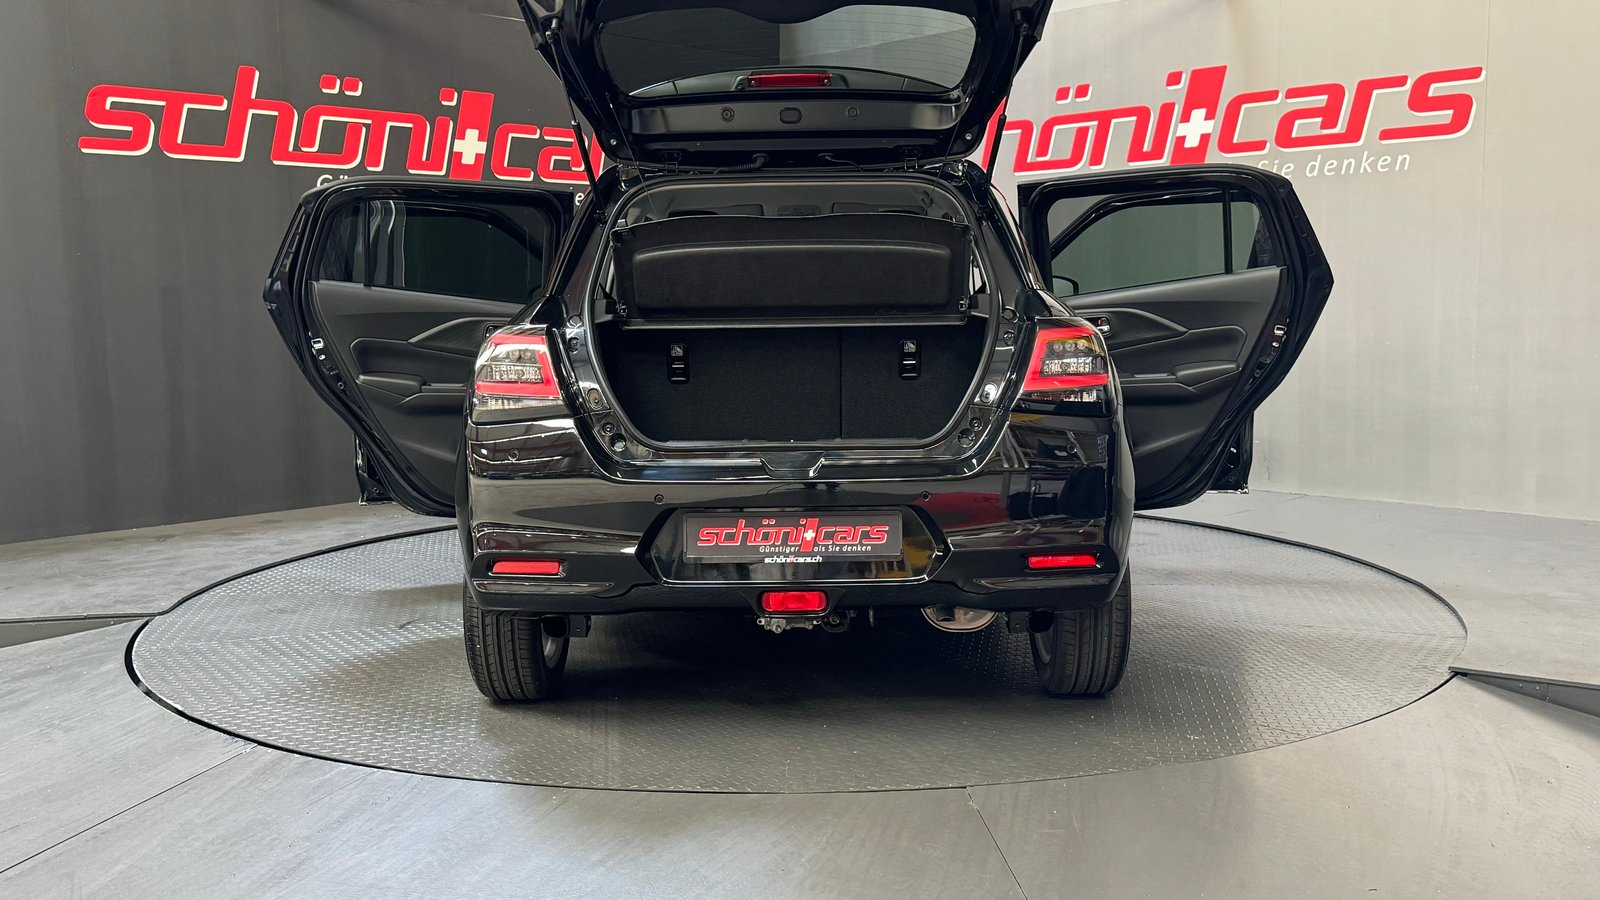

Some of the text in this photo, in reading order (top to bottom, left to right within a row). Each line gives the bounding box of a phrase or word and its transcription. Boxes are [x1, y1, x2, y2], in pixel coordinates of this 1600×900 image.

[1305, 150, 1411, 178] denken
[759, 545, 799, 553] Günstiger
[828, 544, 840, 552] Sie
[842, 544, 872, 552] denken
